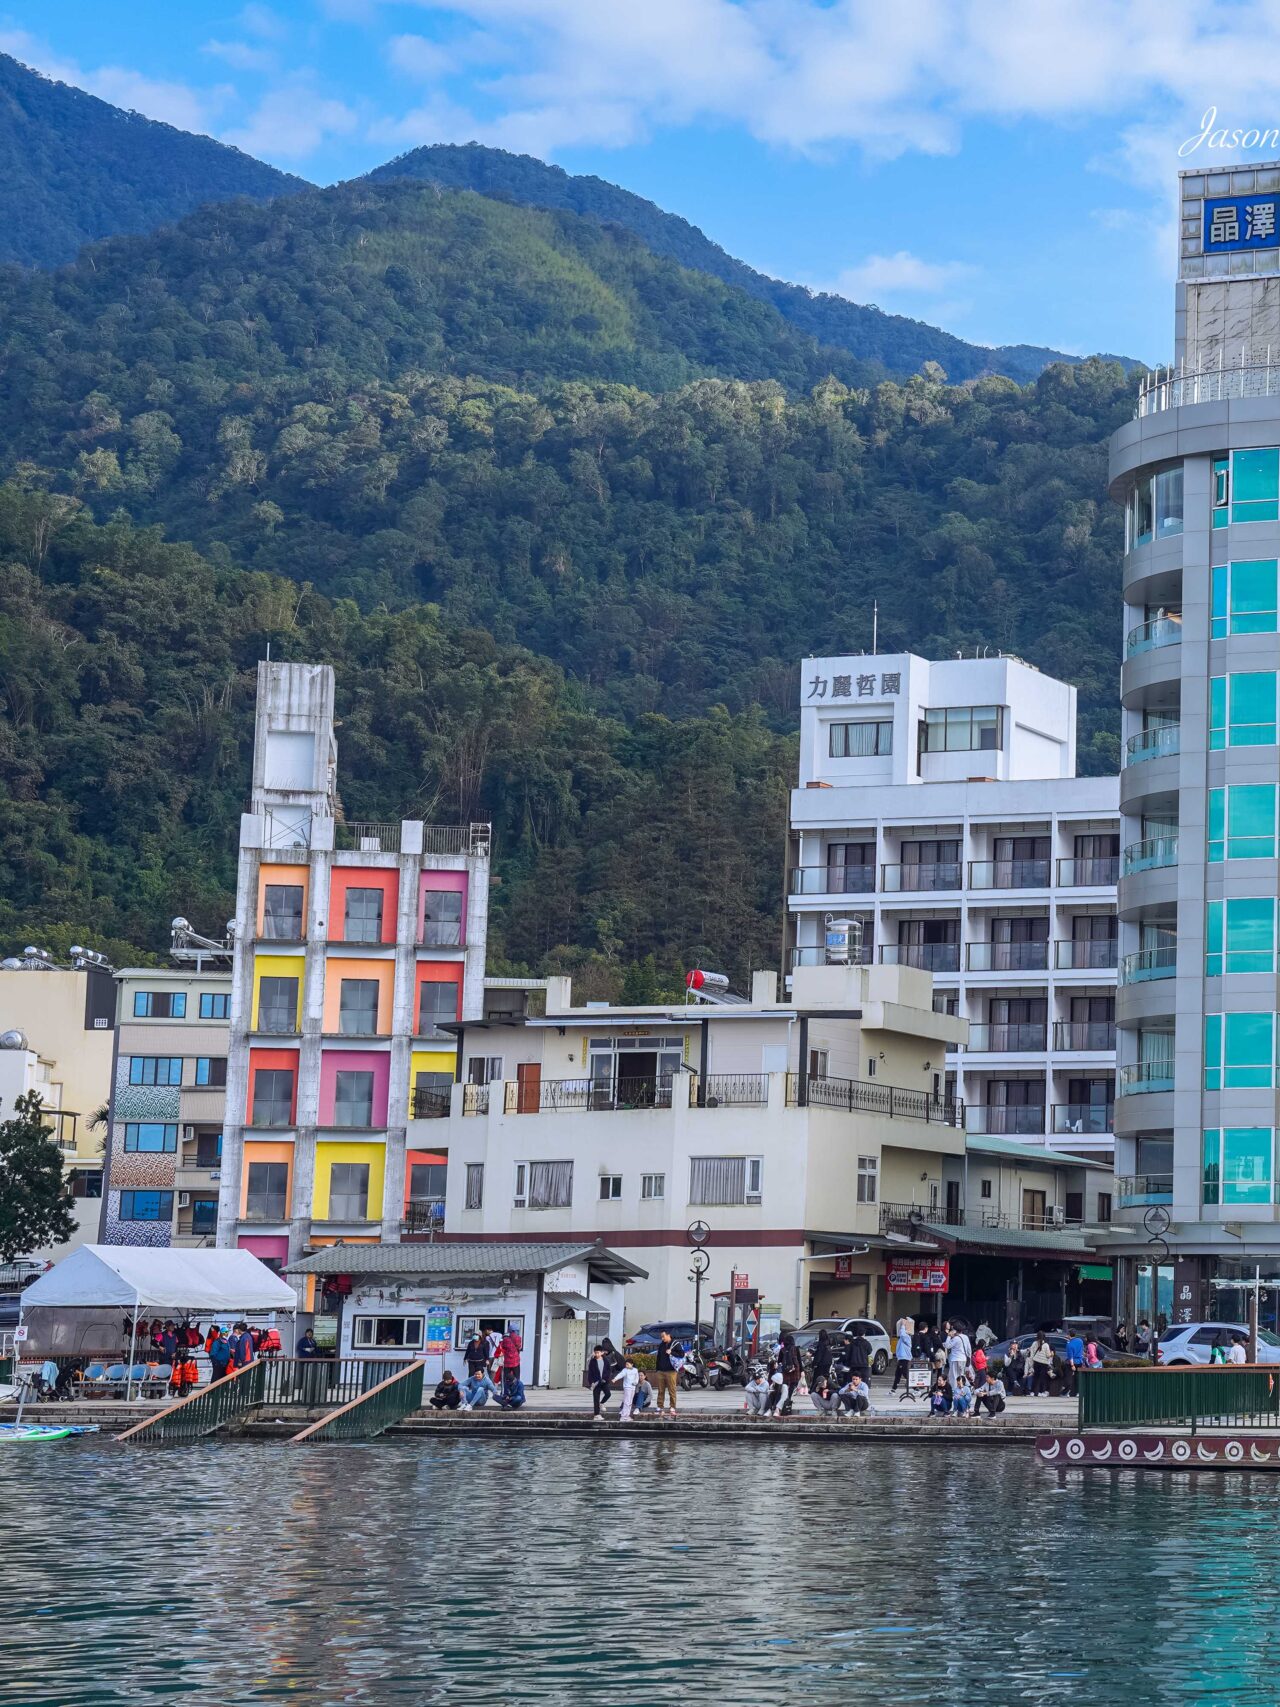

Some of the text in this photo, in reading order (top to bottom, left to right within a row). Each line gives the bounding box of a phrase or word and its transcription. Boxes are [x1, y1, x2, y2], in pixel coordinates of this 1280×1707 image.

[1210, 202, 1276, 244] 晶澤
[807, 672, 902, 699] 力麗哲園
[1178, 1285, 1193, 1323] 晶澤
